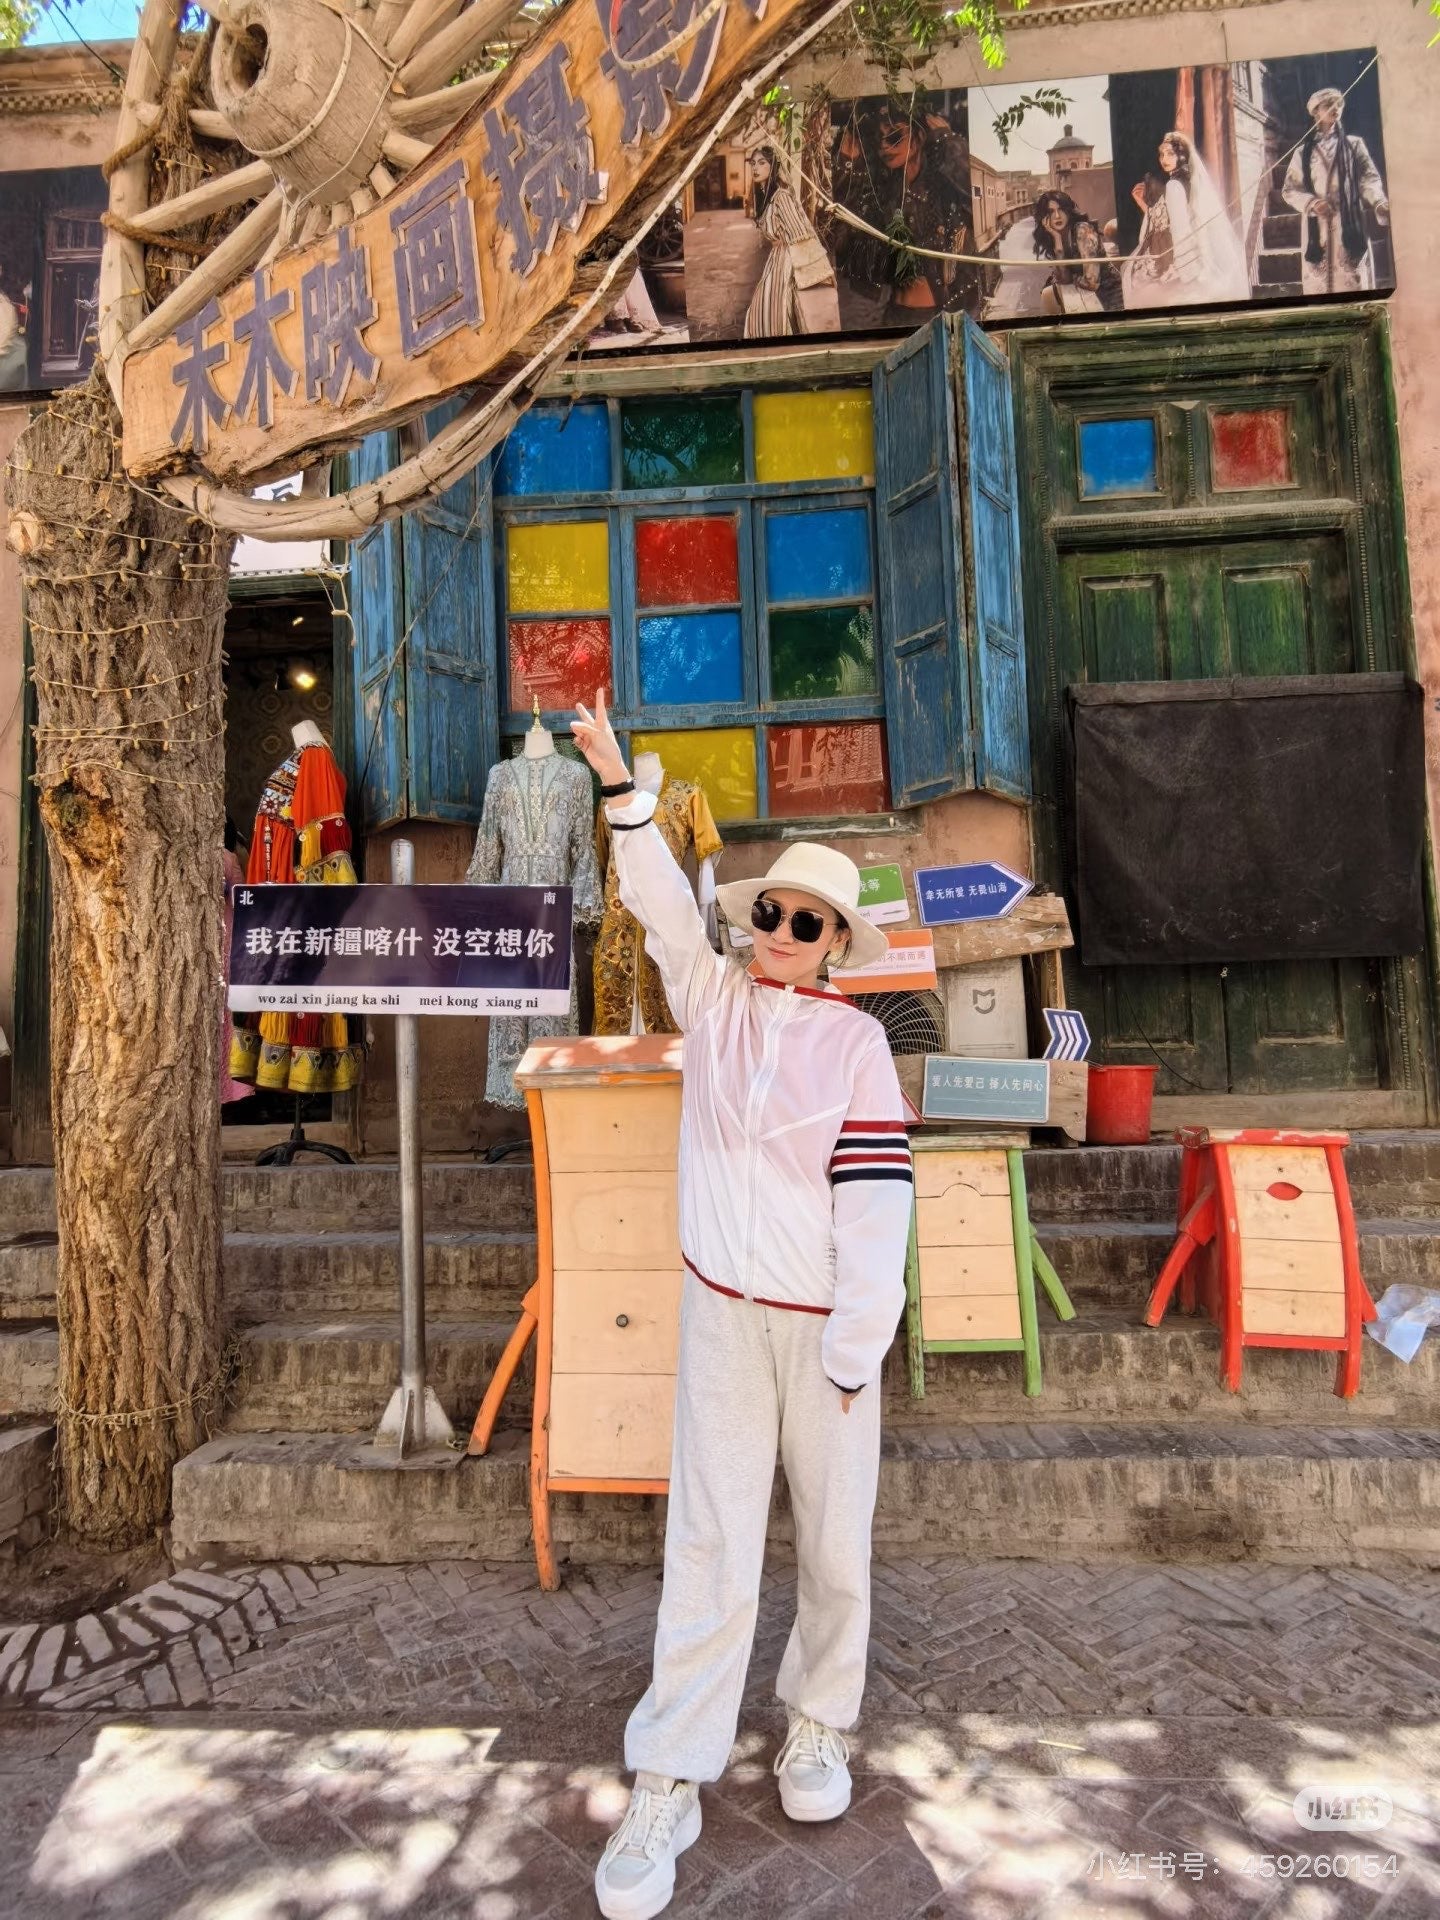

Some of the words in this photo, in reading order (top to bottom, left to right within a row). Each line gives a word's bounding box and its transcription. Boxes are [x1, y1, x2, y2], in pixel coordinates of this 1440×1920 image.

[968, 882, 1008, 896] 无畏山海
[239, 890, 254, 905] 北
[543, 891, 556, 905] 南
[245, 926, 423, 957] 我在新疆喀什
[433, 927, 556, 958] 没空想你
[258, 995, 276, 1004] wo
[280, 994, 298, 1004] zai
[302, 994, 322, 1005] xin
[325, 994, 358, 1007] jiang
[362, 994, 377, 1005] ka
[381, 994, 400, 1006] shi
[419, 995, 443, 1006] mei
[446, 996, 479, 1009] kong
[486, 996, 522, 1010] xiang
[526, 997, 539, 1008] ni
